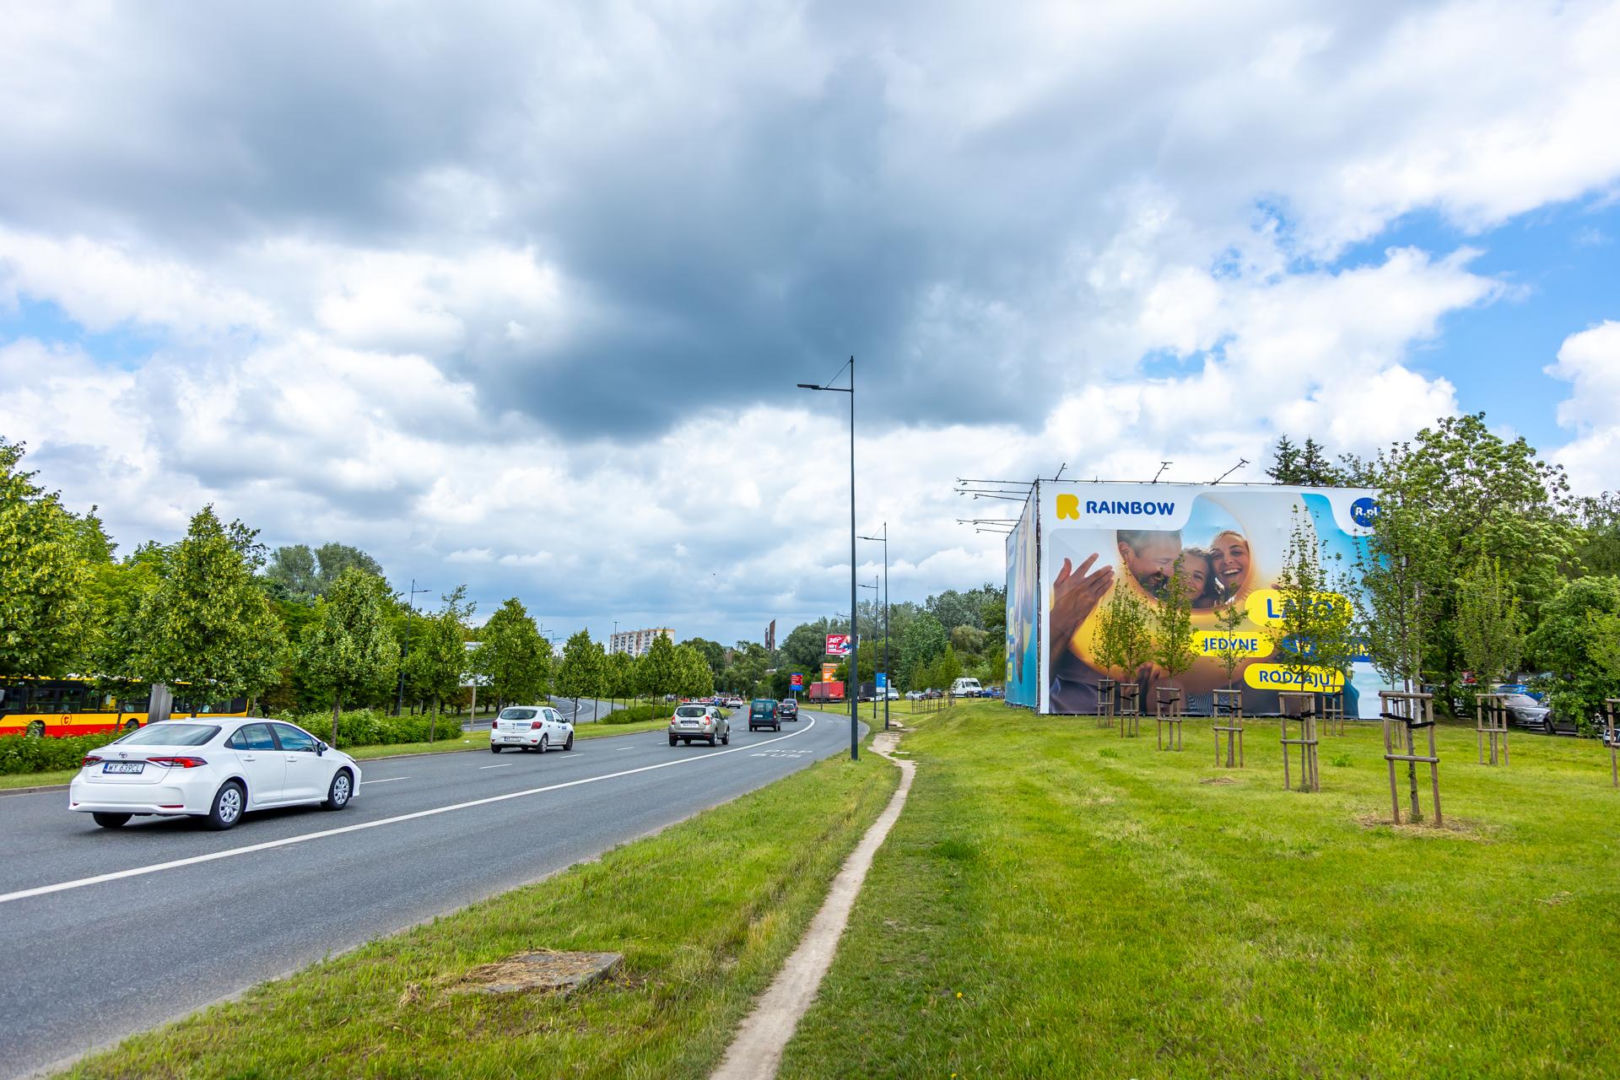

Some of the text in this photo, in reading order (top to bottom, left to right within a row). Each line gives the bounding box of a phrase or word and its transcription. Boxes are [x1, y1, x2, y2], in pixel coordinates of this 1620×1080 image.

[1086, 501, 1175, 515] RAINBOW
[1204, 637, 1258, 652] JEDYNE
[1259, 670, 1330, 687] RODZAJU
